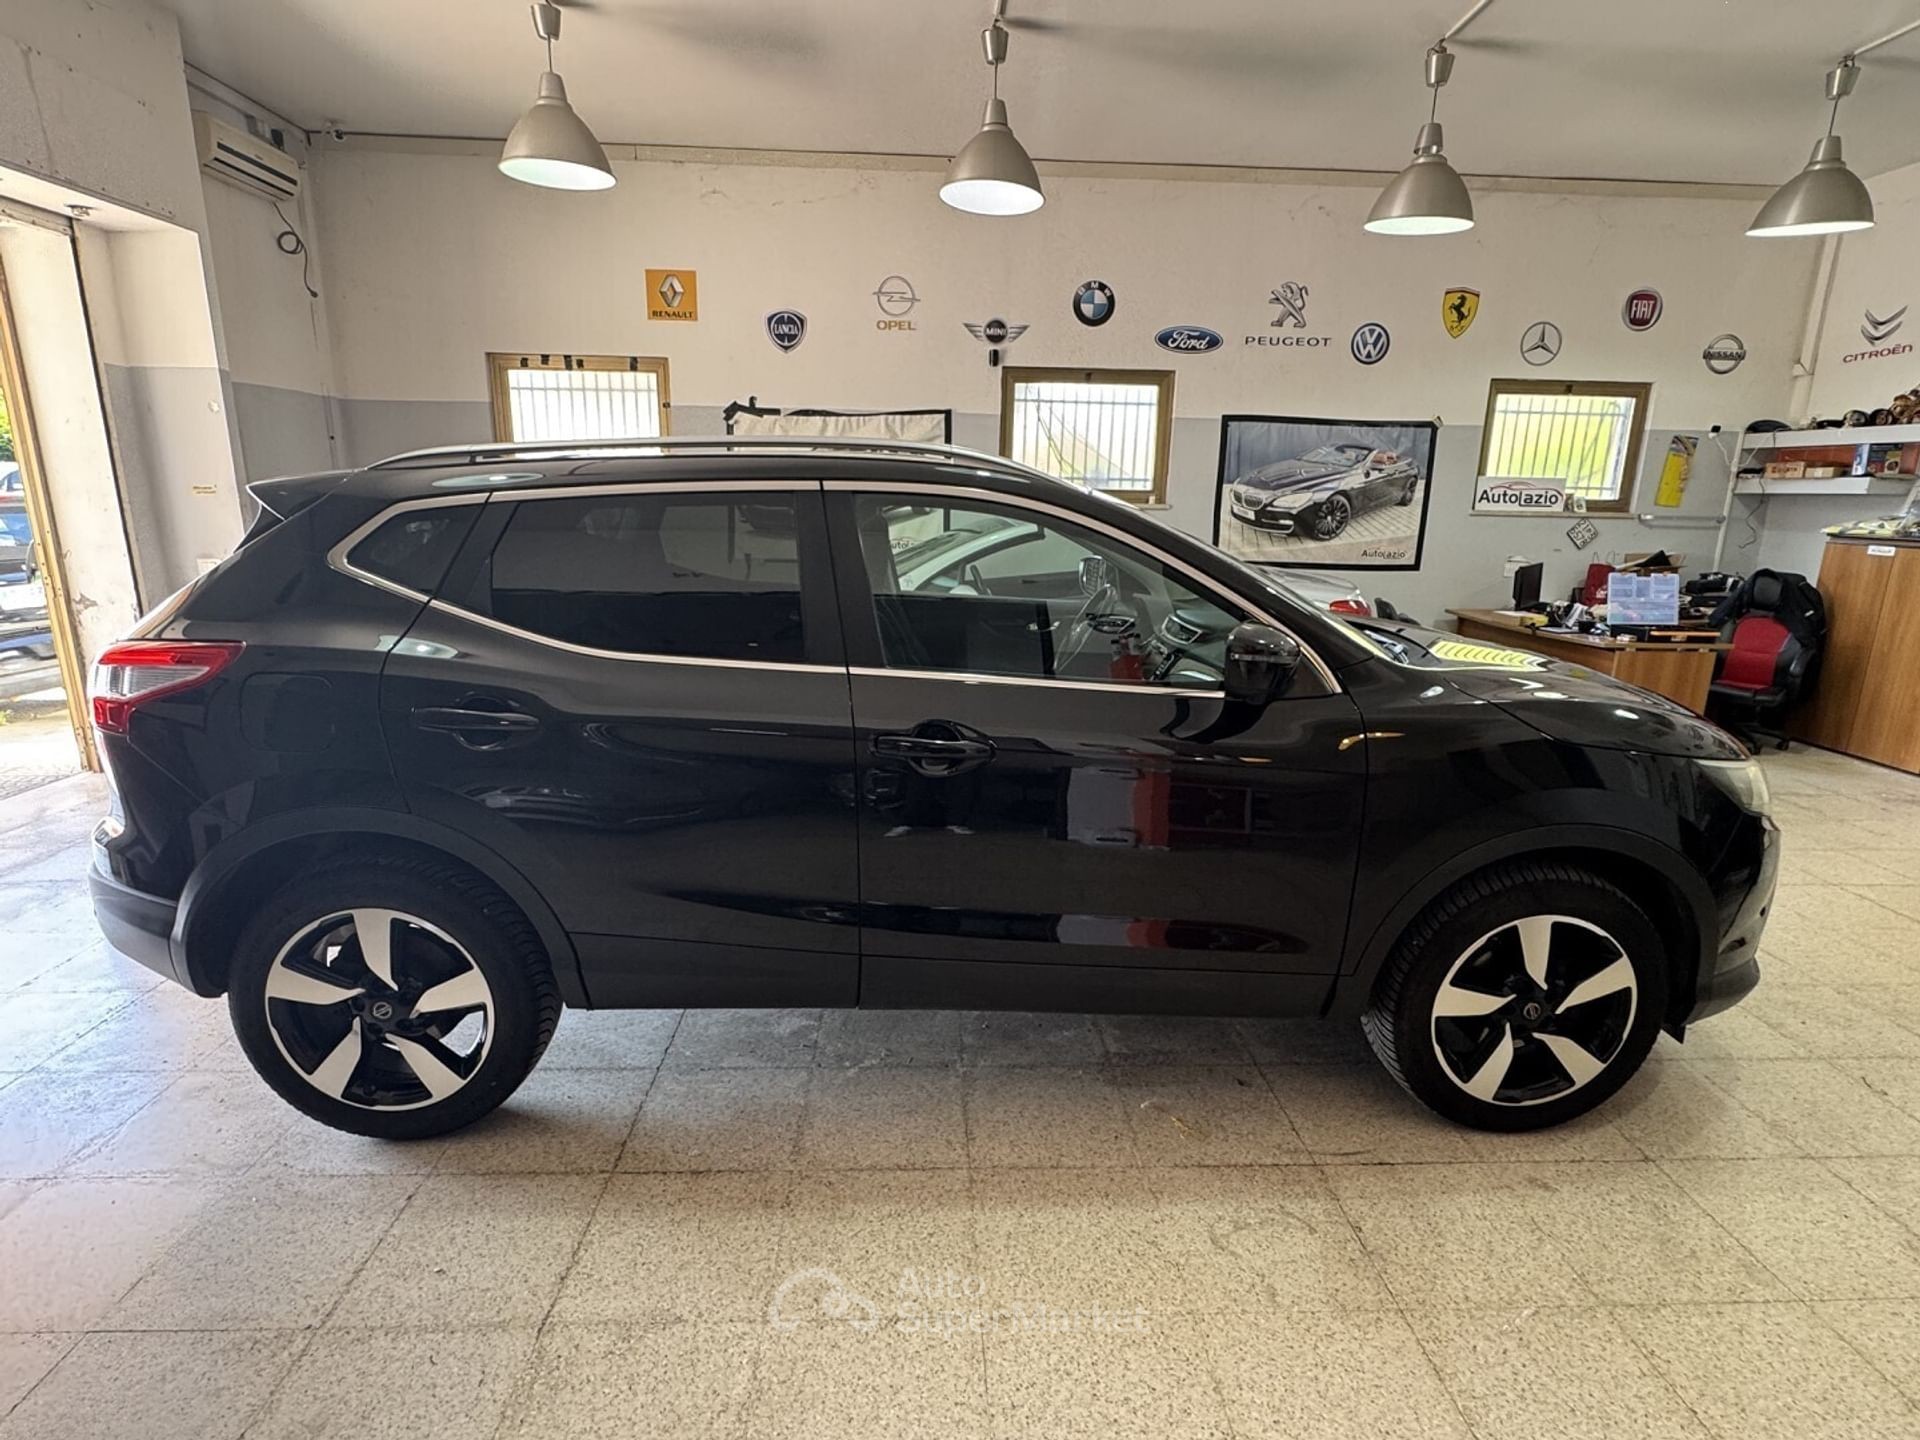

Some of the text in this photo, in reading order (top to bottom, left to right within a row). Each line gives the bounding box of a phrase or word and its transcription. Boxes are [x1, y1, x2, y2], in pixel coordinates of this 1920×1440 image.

[652, 310, 695, 319] RENAULT
[1630, 300, 1655, 319] FIAT
[774, 324, 800, 335] LANCIA
[876, 319, 917, 331] OPEL
[985, 327, 1007, 336] MINI
[1168, 330, 1210, 349] Ford
[1244, 335, 1332, 347] PEUGEOT
[1704, 350, 1744, 360] NISSAN
